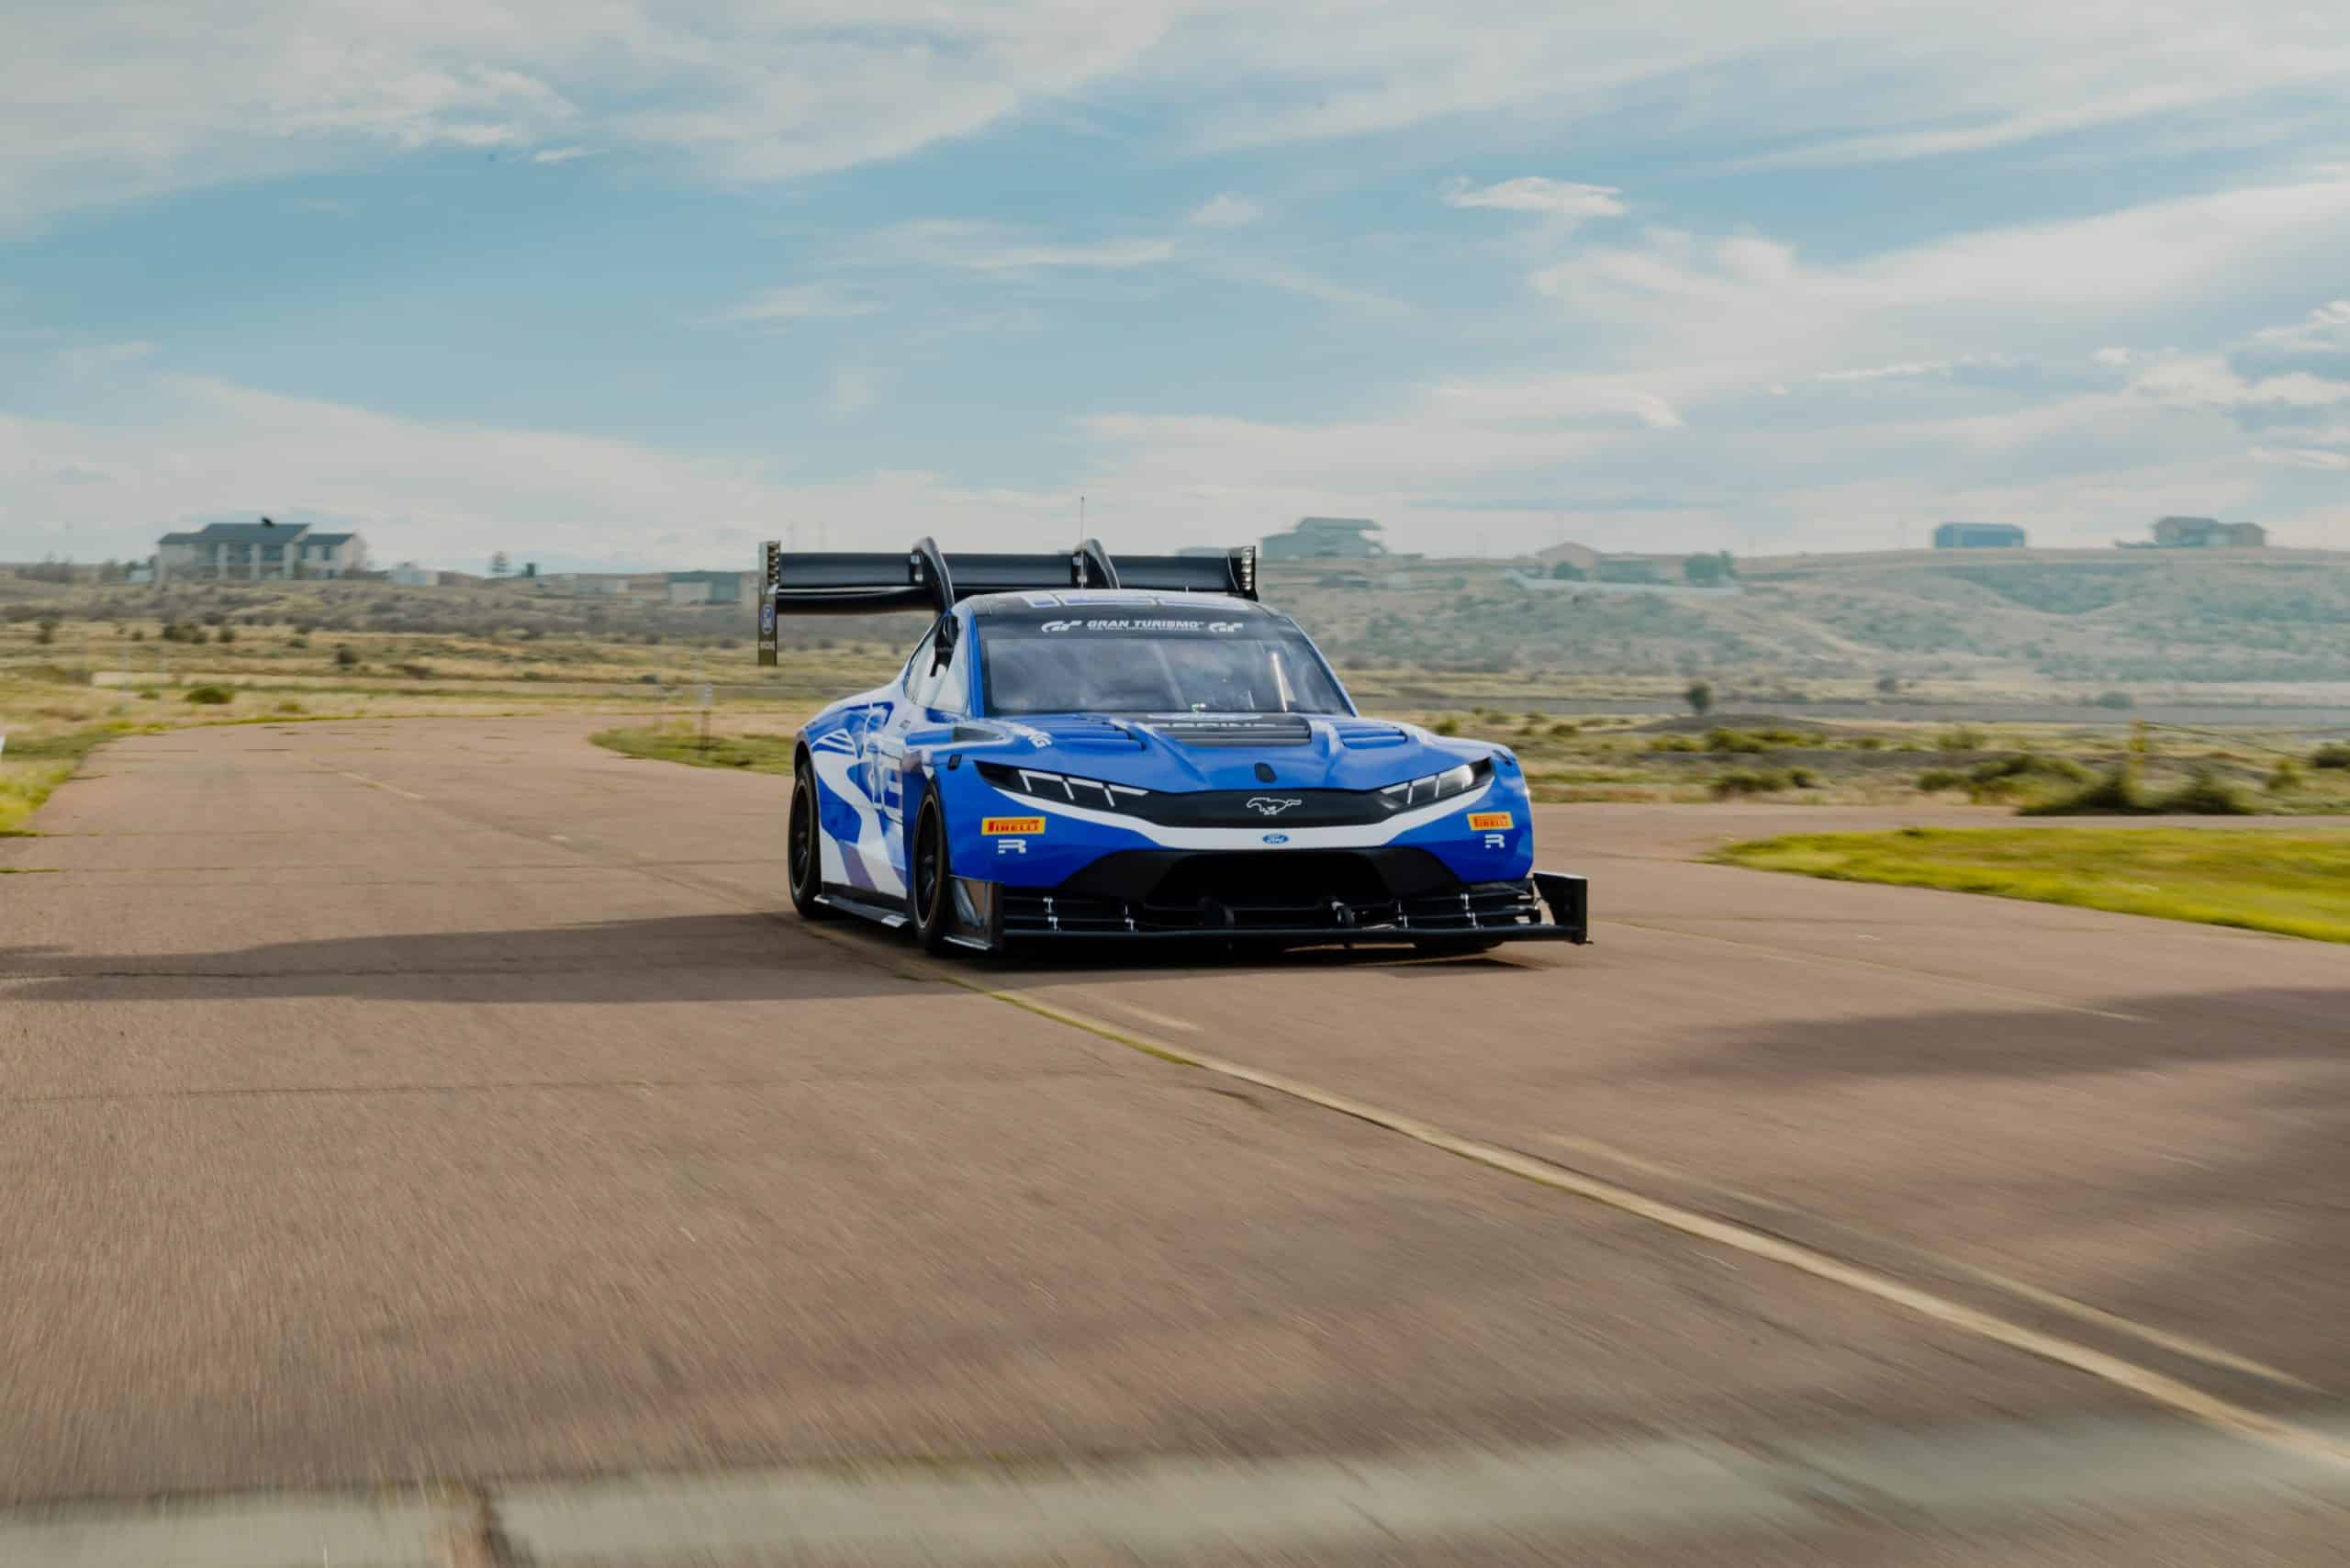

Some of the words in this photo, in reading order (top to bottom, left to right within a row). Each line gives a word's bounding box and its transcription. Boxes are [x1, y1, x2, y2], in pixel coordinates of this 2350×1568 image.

[1087, 620, 1130, 630] GRAN
[1135, 620, 1200, 631] TURISMO
[988, 819, 1040, 832] PIRELLI
